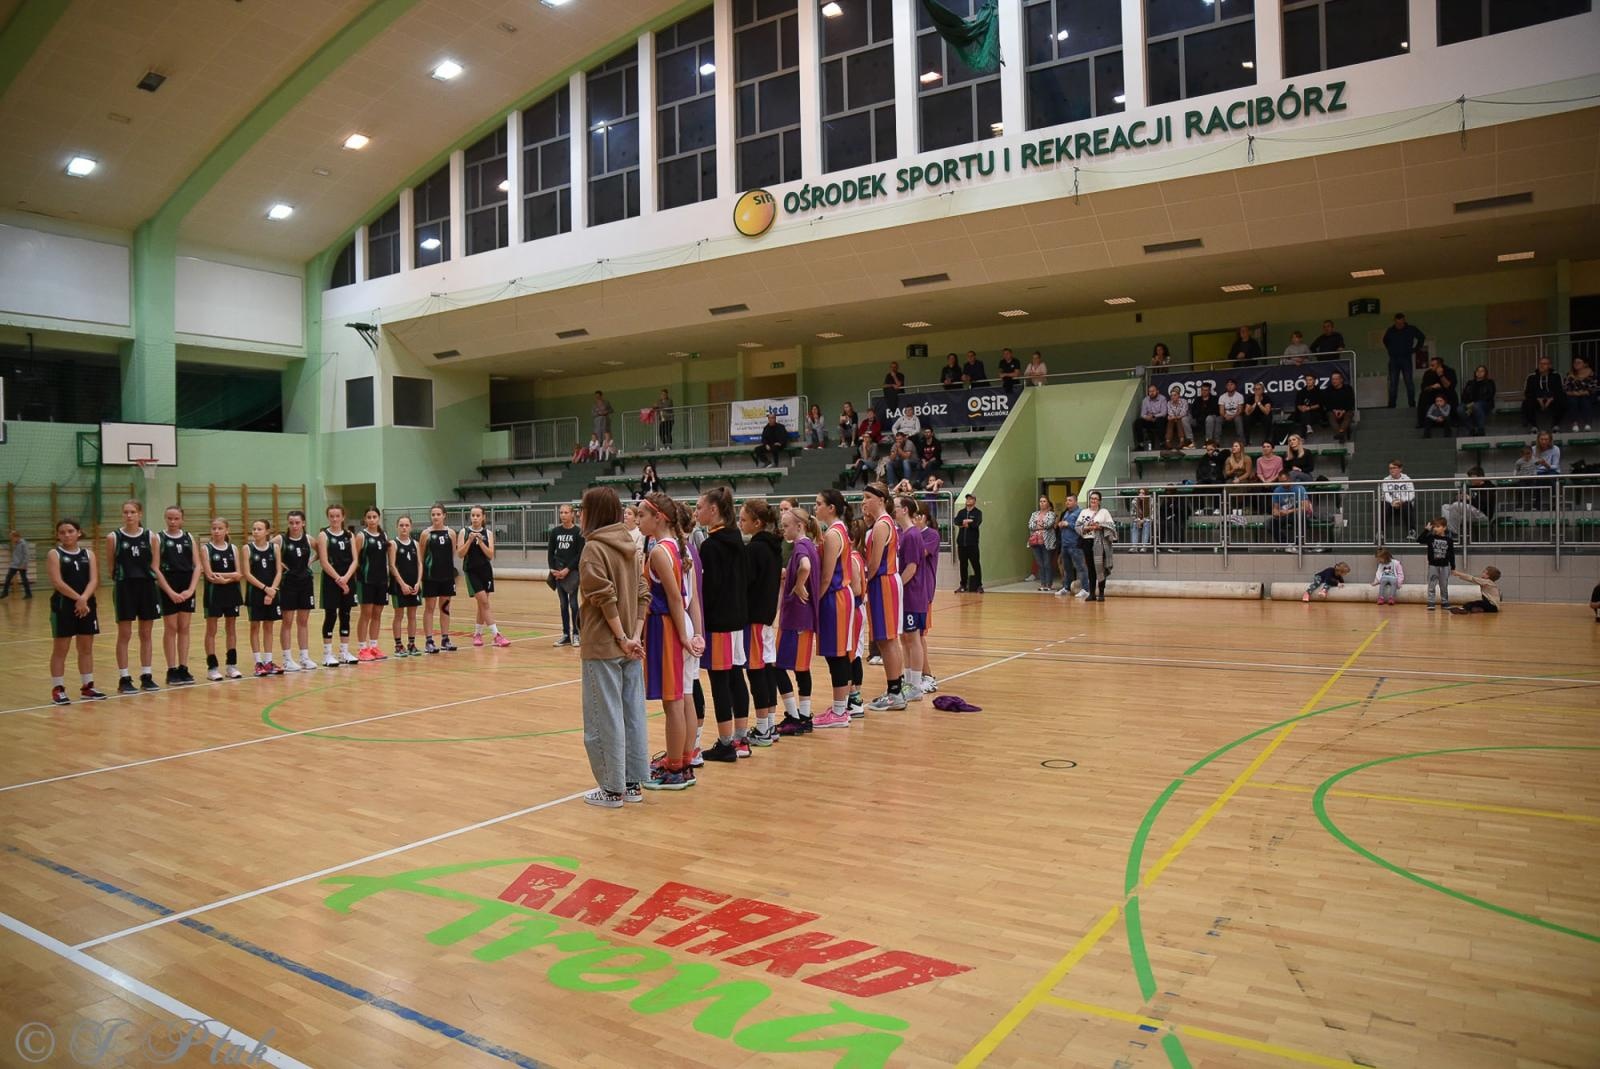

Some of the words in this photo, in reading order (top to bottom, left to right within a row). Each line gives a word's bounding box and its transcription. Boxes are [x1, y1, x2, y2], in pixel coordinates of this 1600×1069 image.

[784, 173, 888, 214] OŚRODEK
[896, 150, 994, 193] SPORTU
[1004, 147, 1011, 172] I
[1021, 114, 1172, 169] REKREACJI
[1185, 80, 1348, 140] RACIBÓRZ
[1244, 375, 1330, 395] RCIBÓZ
[885, 402, 948, 419] RABÓRZ
[968, 395, 1009, 412] OSiR
[907, 614, 915, 626] 8
